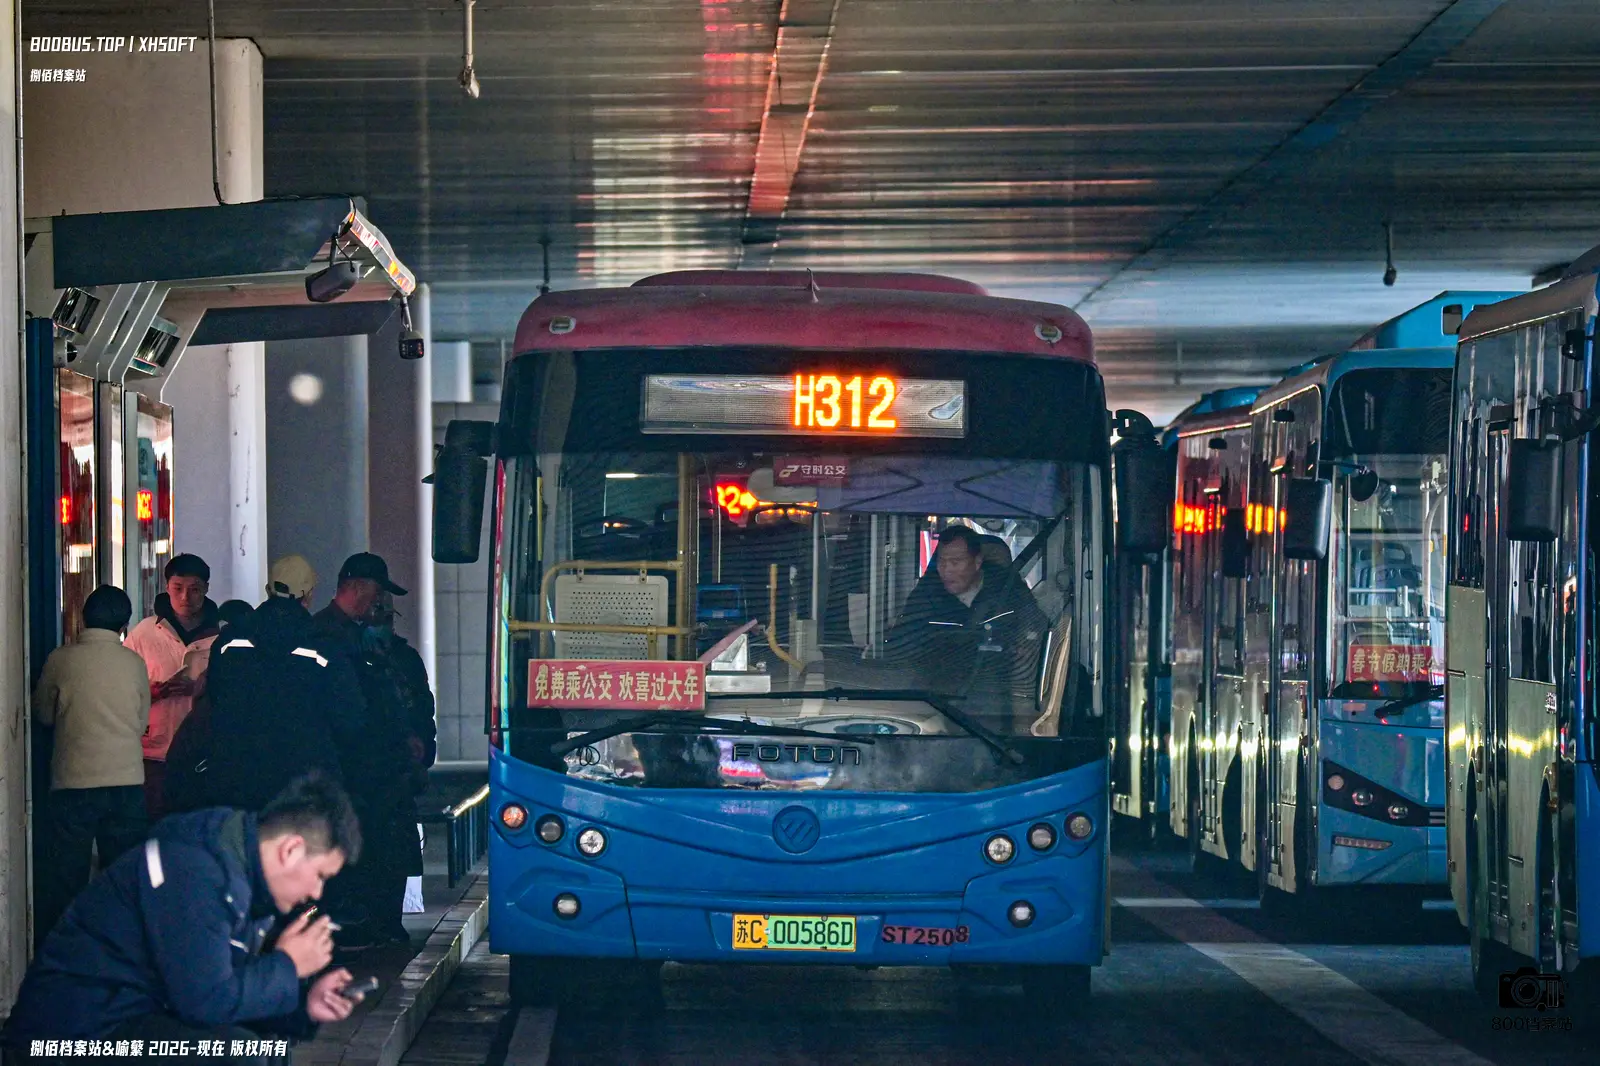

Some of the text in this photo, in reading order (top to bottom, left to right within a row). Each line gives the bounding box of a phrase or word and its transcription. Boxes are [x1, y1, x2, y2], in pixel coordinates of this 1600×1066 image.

[794, 374, 897, 429] H312
[800, 464, 847, 476] 守时公交
[534, 668, 699, 703] 免费乘公交 欢喜过大年
[731, 743, 861, 765] FOTON
[773, 920, 854, 946] 00586D
[881, 925, 969, 946] ST2508
